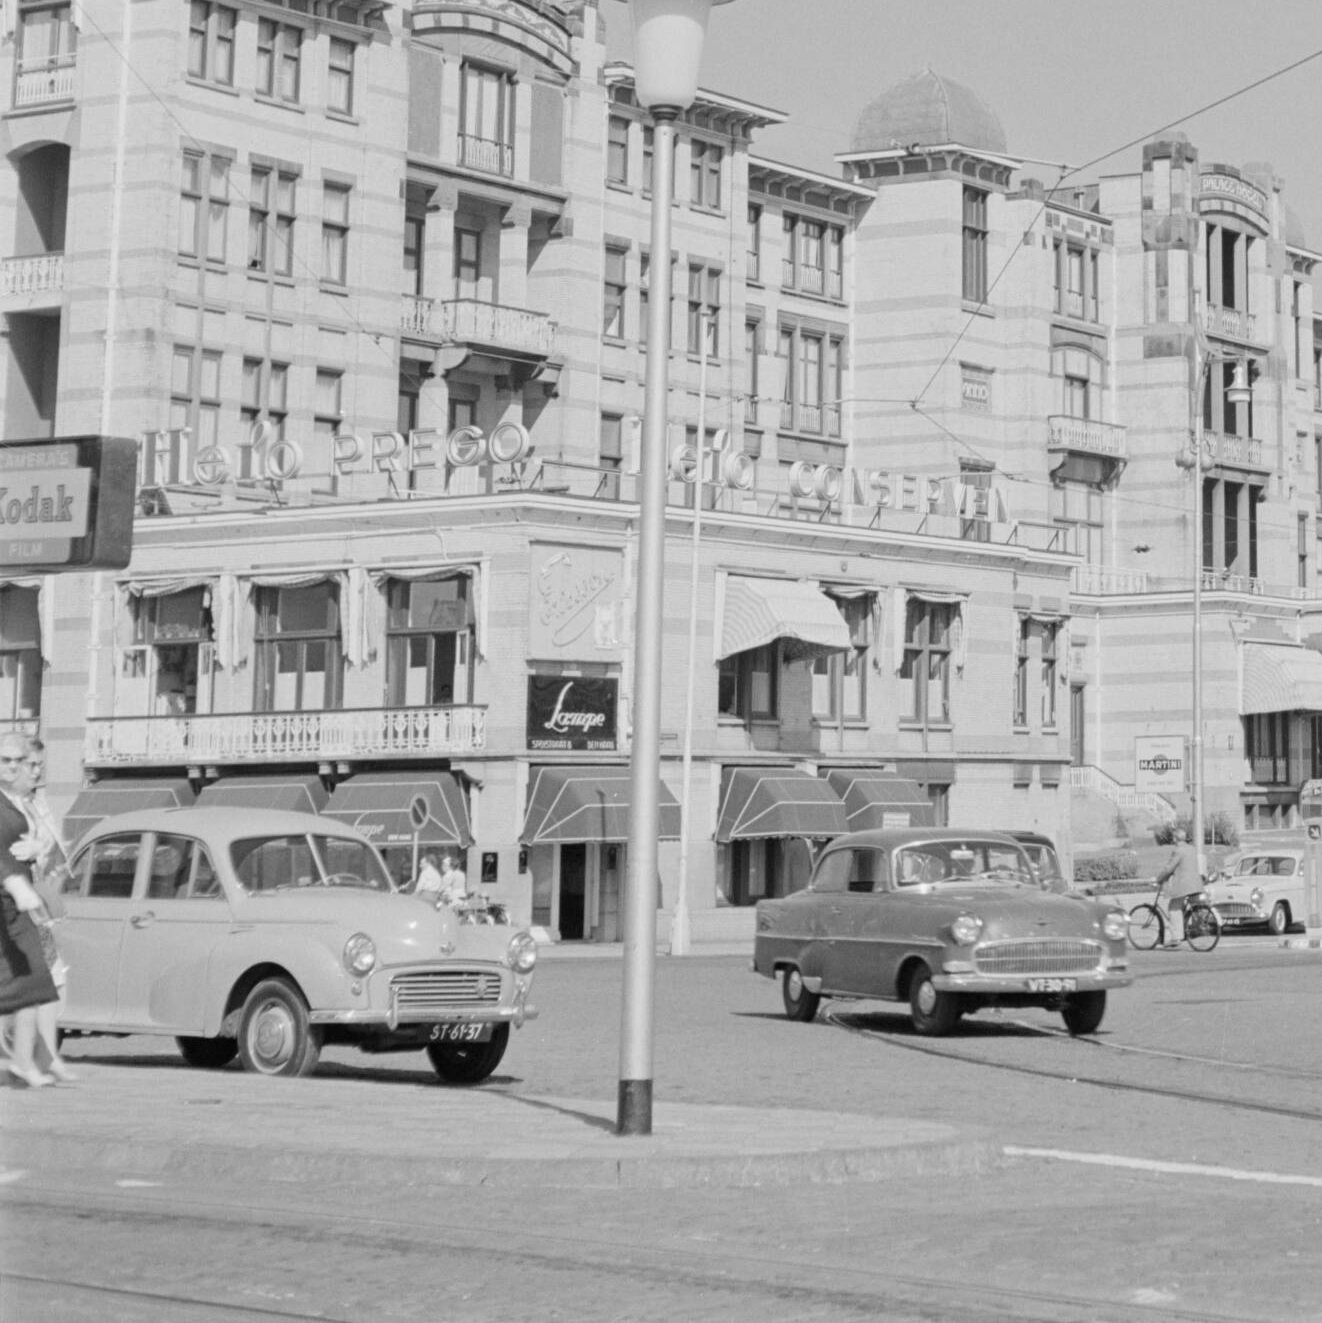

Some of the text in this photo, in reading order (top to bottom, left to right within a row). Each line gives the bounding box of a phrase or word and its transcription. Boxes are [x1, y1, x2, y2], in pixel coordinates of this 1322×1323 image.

[330, 421, 529, 477] PREGO
[8, 541, 43, 557] FILM
[544, 681, 605, 733] Lampe
[1139, 760, 1181, 770] MARTINI
